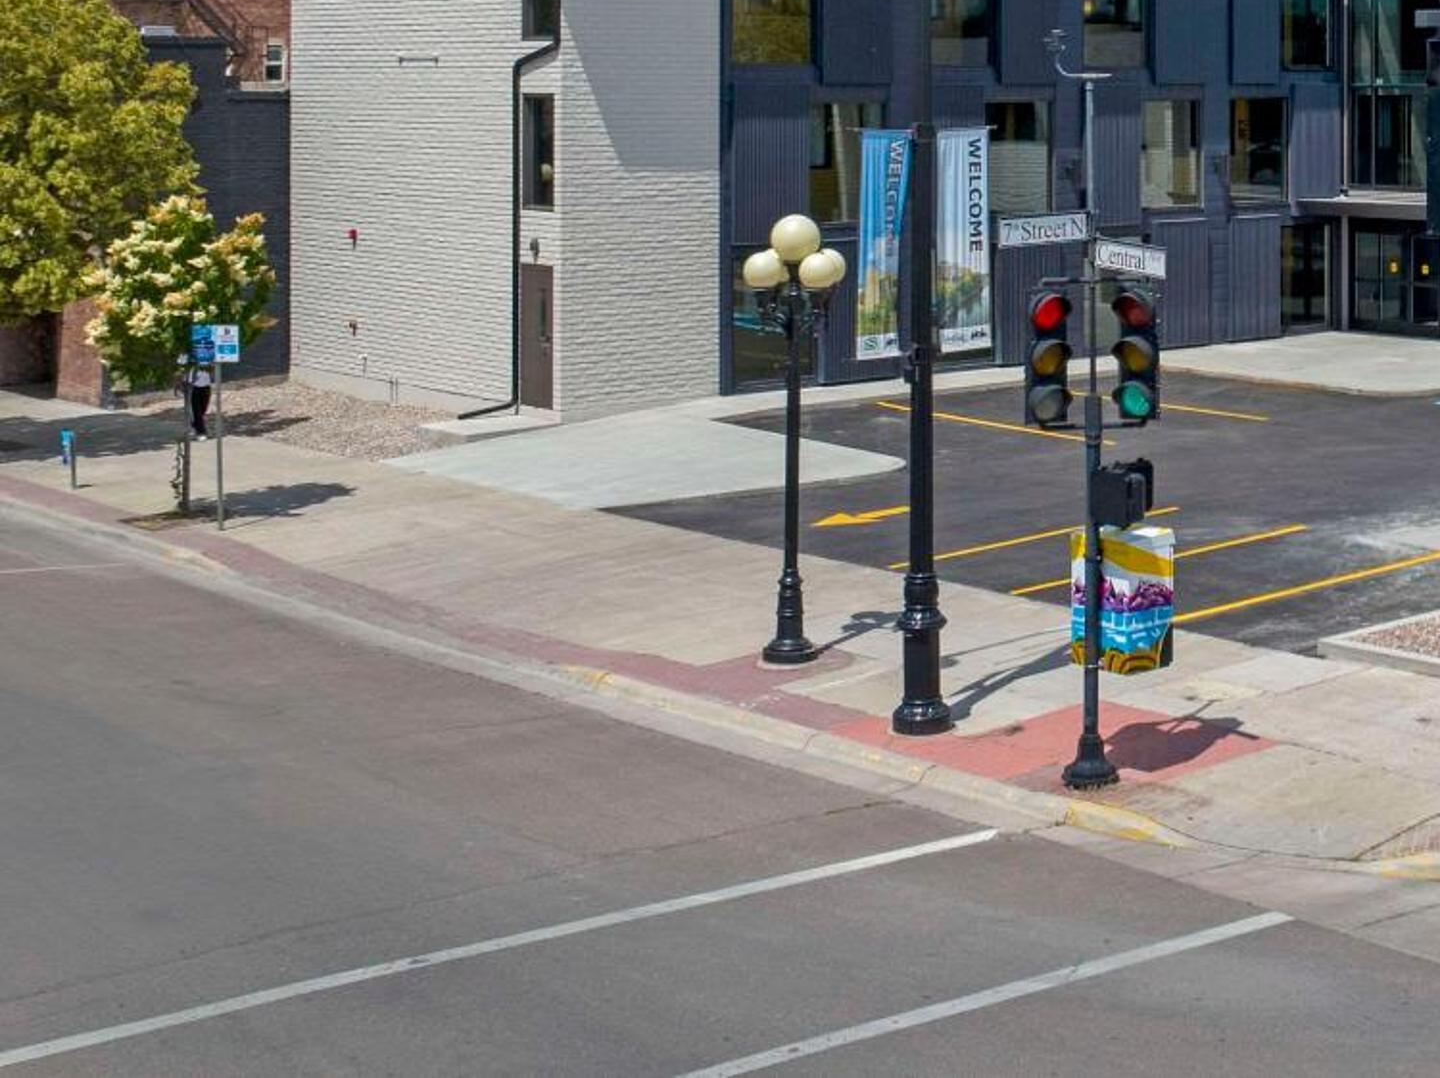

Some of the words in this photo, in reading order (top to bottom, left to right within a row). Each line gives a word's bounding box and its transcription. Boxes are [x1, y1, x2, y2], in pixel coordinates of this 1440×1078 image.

[968, 138, 983, 253] WELCOME
[1021, 221, 1067, 240] Street
[1069, 217, 1084, 236] N
[1098, 243, 1146, 270] Central
